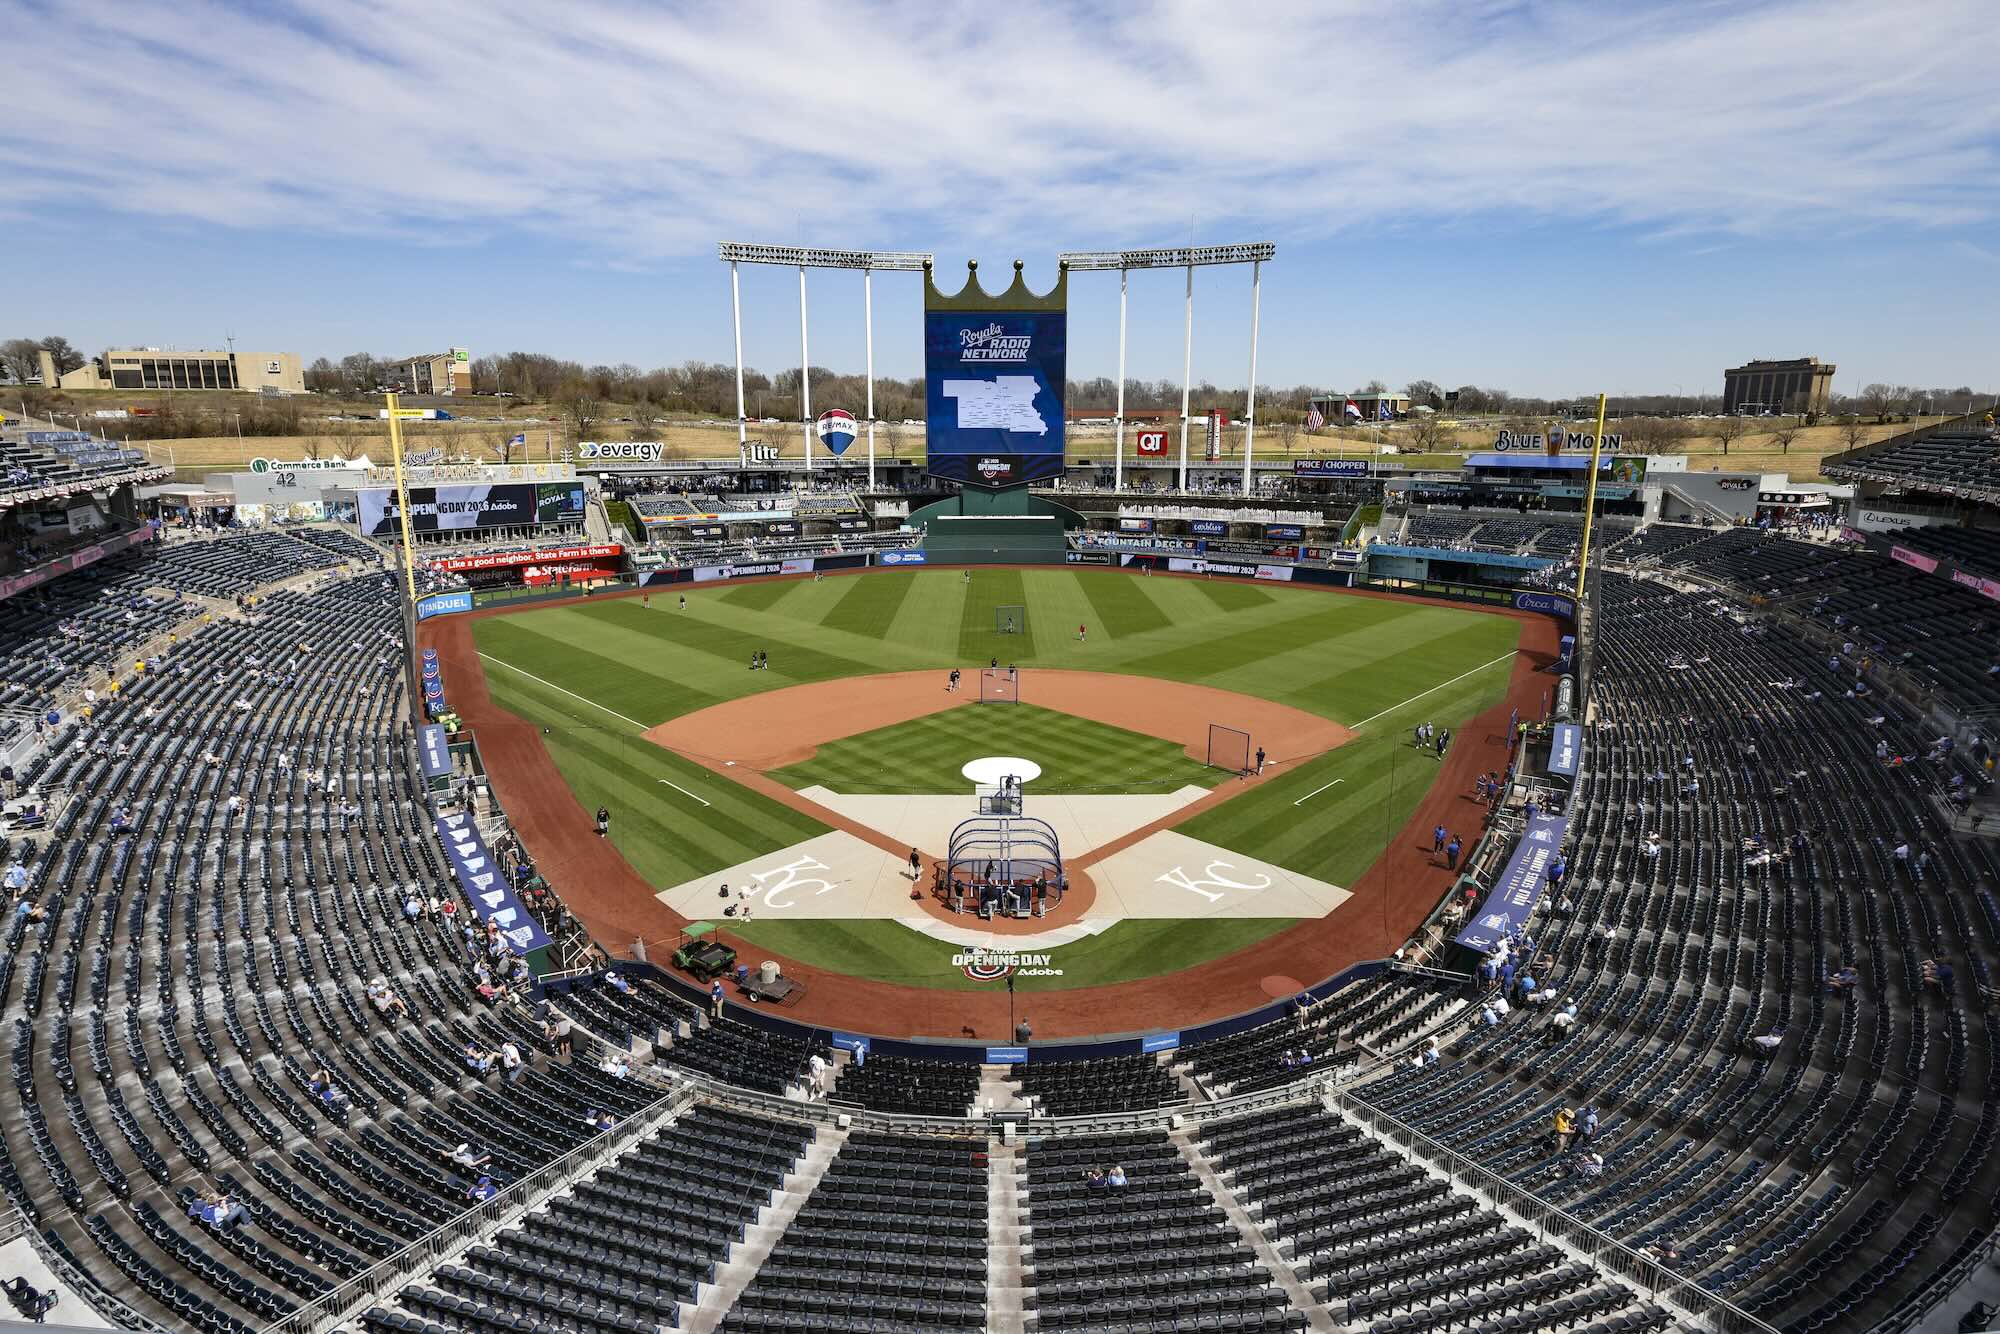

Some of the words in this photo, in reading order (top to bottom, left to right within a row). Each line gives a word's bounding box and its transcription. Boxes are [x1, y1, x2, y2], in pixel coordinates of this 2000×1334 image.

[960, 323, 1002, 347] Royals
[990, 338, 1031, 349] RADIO
[962, 349, 1028, 359] NETWORK
[822, 421, 852, 432] RE/MAX
[1140, 434, 1164, 452] QT
[1495, 430, 1541, 451] BLUE
[1567, 434, 1620, 450] MOON
[404, 447, 440, 466] Royals
[601, 444, 662, 461] evergy
[750, 444, 778, 464] Lite
[271, 462, 322, 473] Commerce
[324, 461, 346, 471] Bank
[1296, 460, 1321, 469] PRICE
[1325, 461, 1366, 470] CHOPPER
[368, 466, 416, 480] HAL
[434, 464, 480, 480] FAME
[276, 473, 297, 487] 42
[1721, 482, 1748, 490] RIVALS
[538, 493, 567, 508] ROYAL
[449, 502, 466, 513] DAY
[467, 501, 490, 512] 2026
[490, 501, 518, 511] Adobe
[1876, 516, 1911, 526] LEXUS
[1098, 538, 1153, 548] FOUNTAIN
[1155, 540, 1183, 548] DECK
[447, 559, 466, 570] Like
[473, 556, 495, 569] good
[536, 552, 558, 562] State
[559, 550, 580, 560] Farm
[589, 547, 612, 558] there.
[732, 566, 756, 576] OPENING
[756, 566, 766, 574] DAY
[766, 564, 780, 573] 2026
[1205, 564, 1228, 574] OPENING
[1229, 565, 1240, 574] DAY
[1240, 566, 1255, 575] 2026
[424, 599, 467, 613] FANDUEL
[1516, 593, 1550, 609] Circa
[430, 702, 444, 712] KC
[751, 855, 838, 908] KC
[1154, 860, 1271, 902] KC
[1465, 935, 1491, 948] KC
[990, 947, 1016, 955] 2026
[952, 954, 1020, 966] OPENING
[1020, 954, 1052, 966] DAY
[1017, 968, 1064, 976] Adobe
